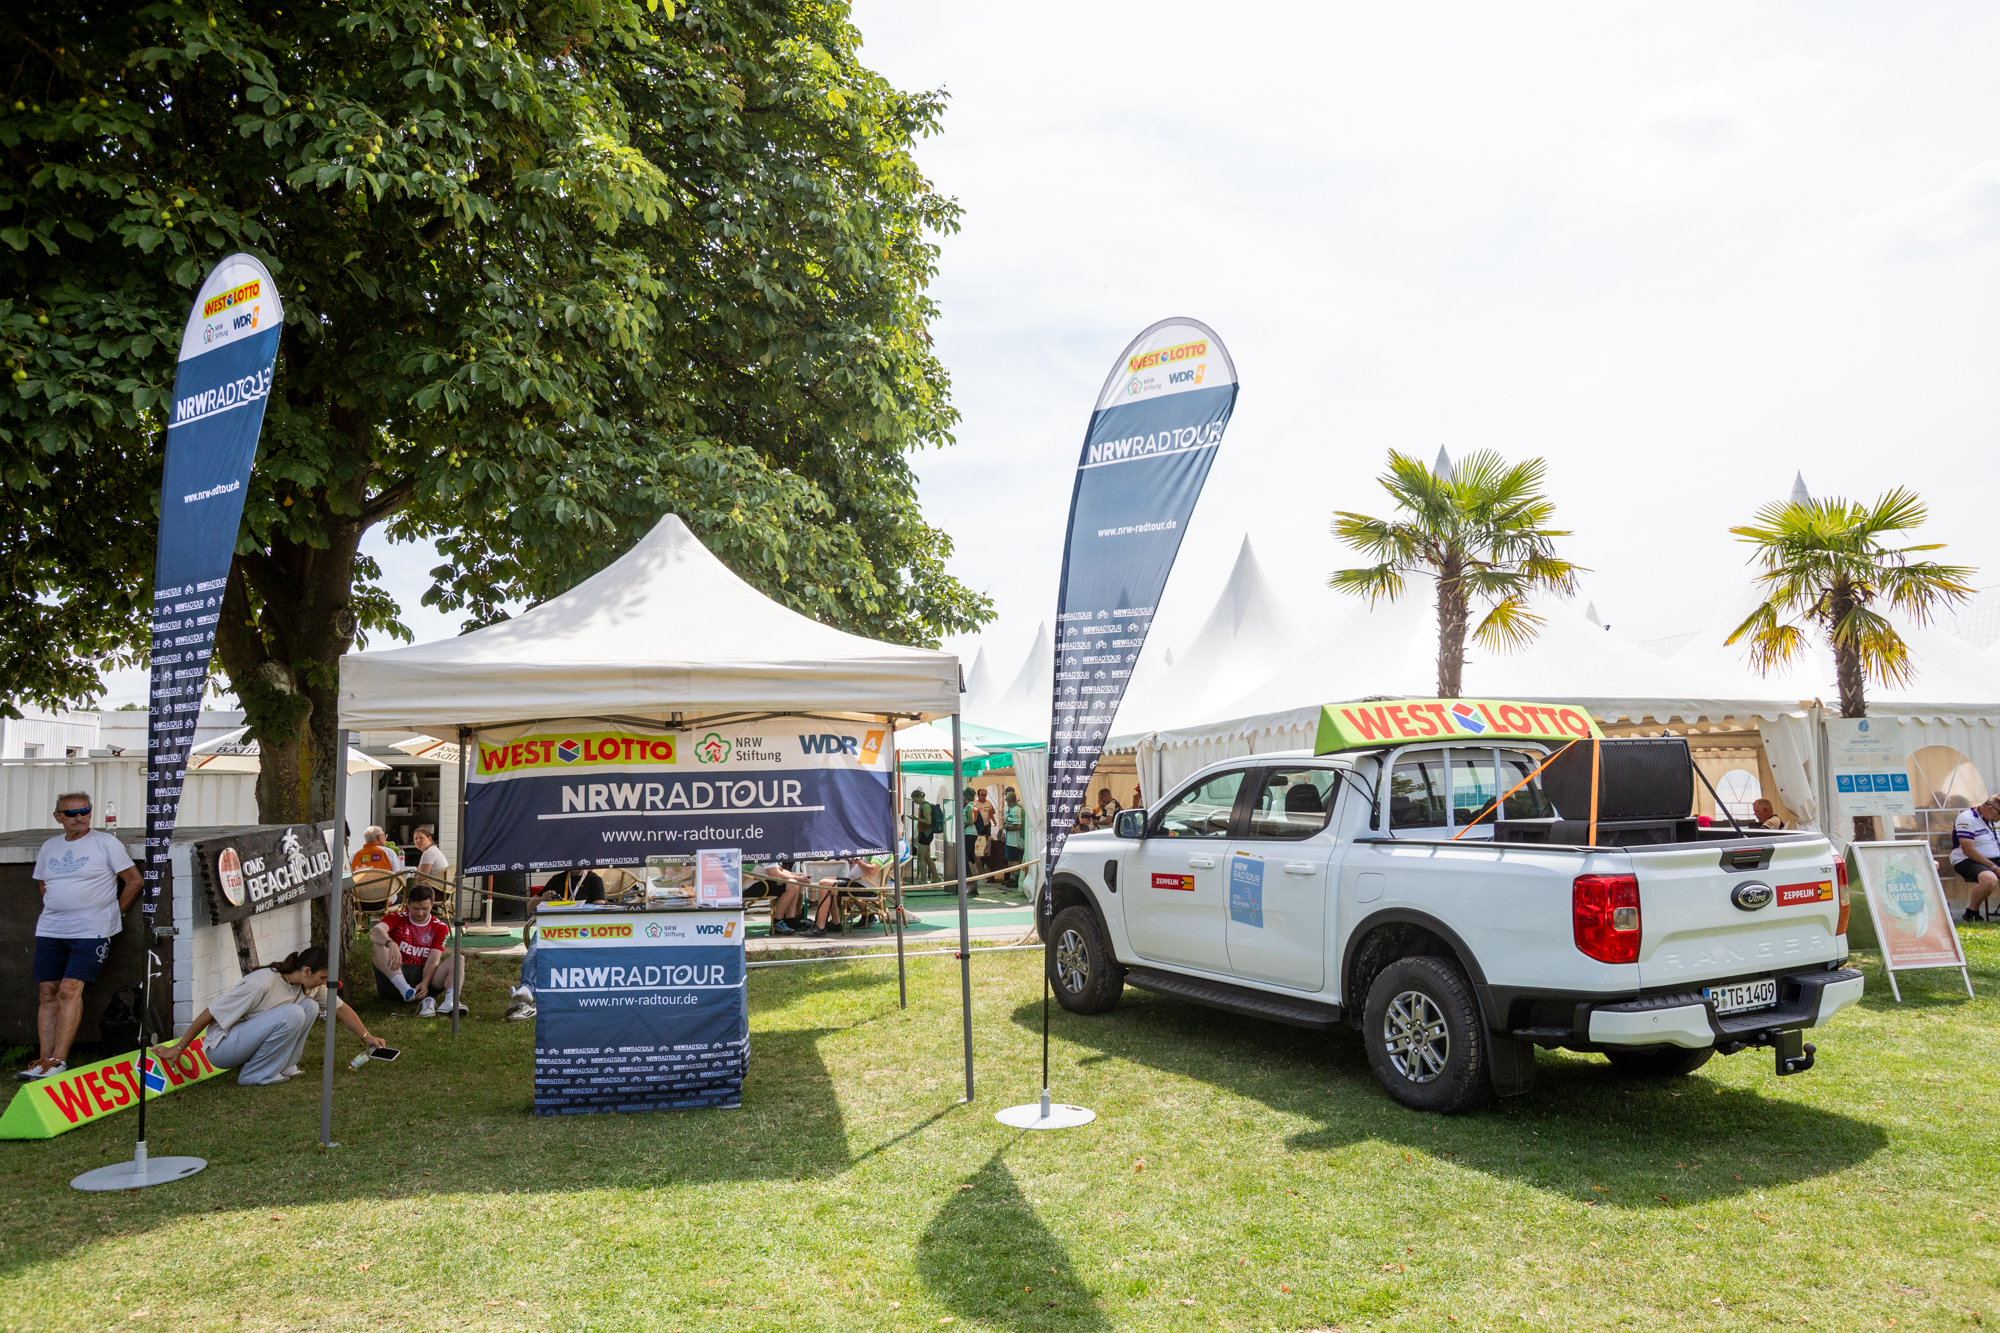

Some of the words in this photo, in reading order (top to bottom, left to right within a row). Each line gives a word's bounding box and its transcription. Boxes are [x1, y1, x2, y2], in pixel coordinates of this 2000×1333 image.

[205, 295, 227, 316] WEST
[234, 282, 260, 304] LOTTO
[233, 312, 252, 330] WDR
[253, 310, 258, 319] 4
[1130, 353, 1160, 371] WEST
[1170, 343, 1206, 361] LOTTO
[1169, 370, 1194, 384] WDR
[1196, 367, 1203, 377] 4
[1089, 421, 1223, 464] NRWRADTOUR
[1098, 520, 1177, 537] www.nrw-radtour.de
[197, 578, 227, 591] NRWRADTOUR
[175, 600, 204, 612] NRWRADTOUR
[1113, 607, 1154, 617] NRWRADTOUR
[1083, 625, 1122, 633] NRWRADTOUR
[1083, 655, 1121, 664] NRWRADTOUR
[1340, 704, 1455, 740] WEST
[1477, 703, 1591, 736] LOTTO
[735, 736, 763, 748] NRW
[799, 733, 859, 756] WDR
[864, 737, 878, 753] 4
[480, 740, 555, 771] WEST
[584, 737, 673, 762] LOTTO
[735, 747, 782, 763] Stiftung
[562, 780, 803, 813] NRWRADTOUR
[601, 825, 764, 844] www.nrw-radtour.de
[242, 857, 265, 876] OMS
[530, 860, 572, 868] NRWRADTOUR
[596, 857, 639, 865] NRWRADTOUR
[1234, 862, 1249, 871] NRW
[247, 863, 295, 902] BEACH
[300, 851, 332, 881] CLUB
[1233, 870, 1260, 883] RADTOUR
[1783, 889, 1814, 900] ZEPPELIN
[1888, 883, 1918, 892] BEACH
[1748, 889, 1767, 903] Ford
[1893, 893, 1920, 902] VIBES
[542, 928, 579, 939] WEST
[590, 925, 632, 938] LOTTO
[664, 931, 685, 939] Stiftung
[696, 924, 724, 935] WDR
[727, 924, 733, 932] 4
[399, 941, 430, 957] REWE
[1662, 935, 1825, 970] RANGER
[550, 965, 725, 988] NRWRADTOUR
[579, 993, 698, 1007] www.nrw-radtour.de
[1711, 991, 1720, 1009] B
[1728, 988, 1743, 1006] TG
[1746, 983, 1774, 1004] 1409
[701, 1051, 734, 1059] NRWRADTOUR
[44, 1060, 141, 1123] WEST
[160, 1036, 213, 1086] LOT
